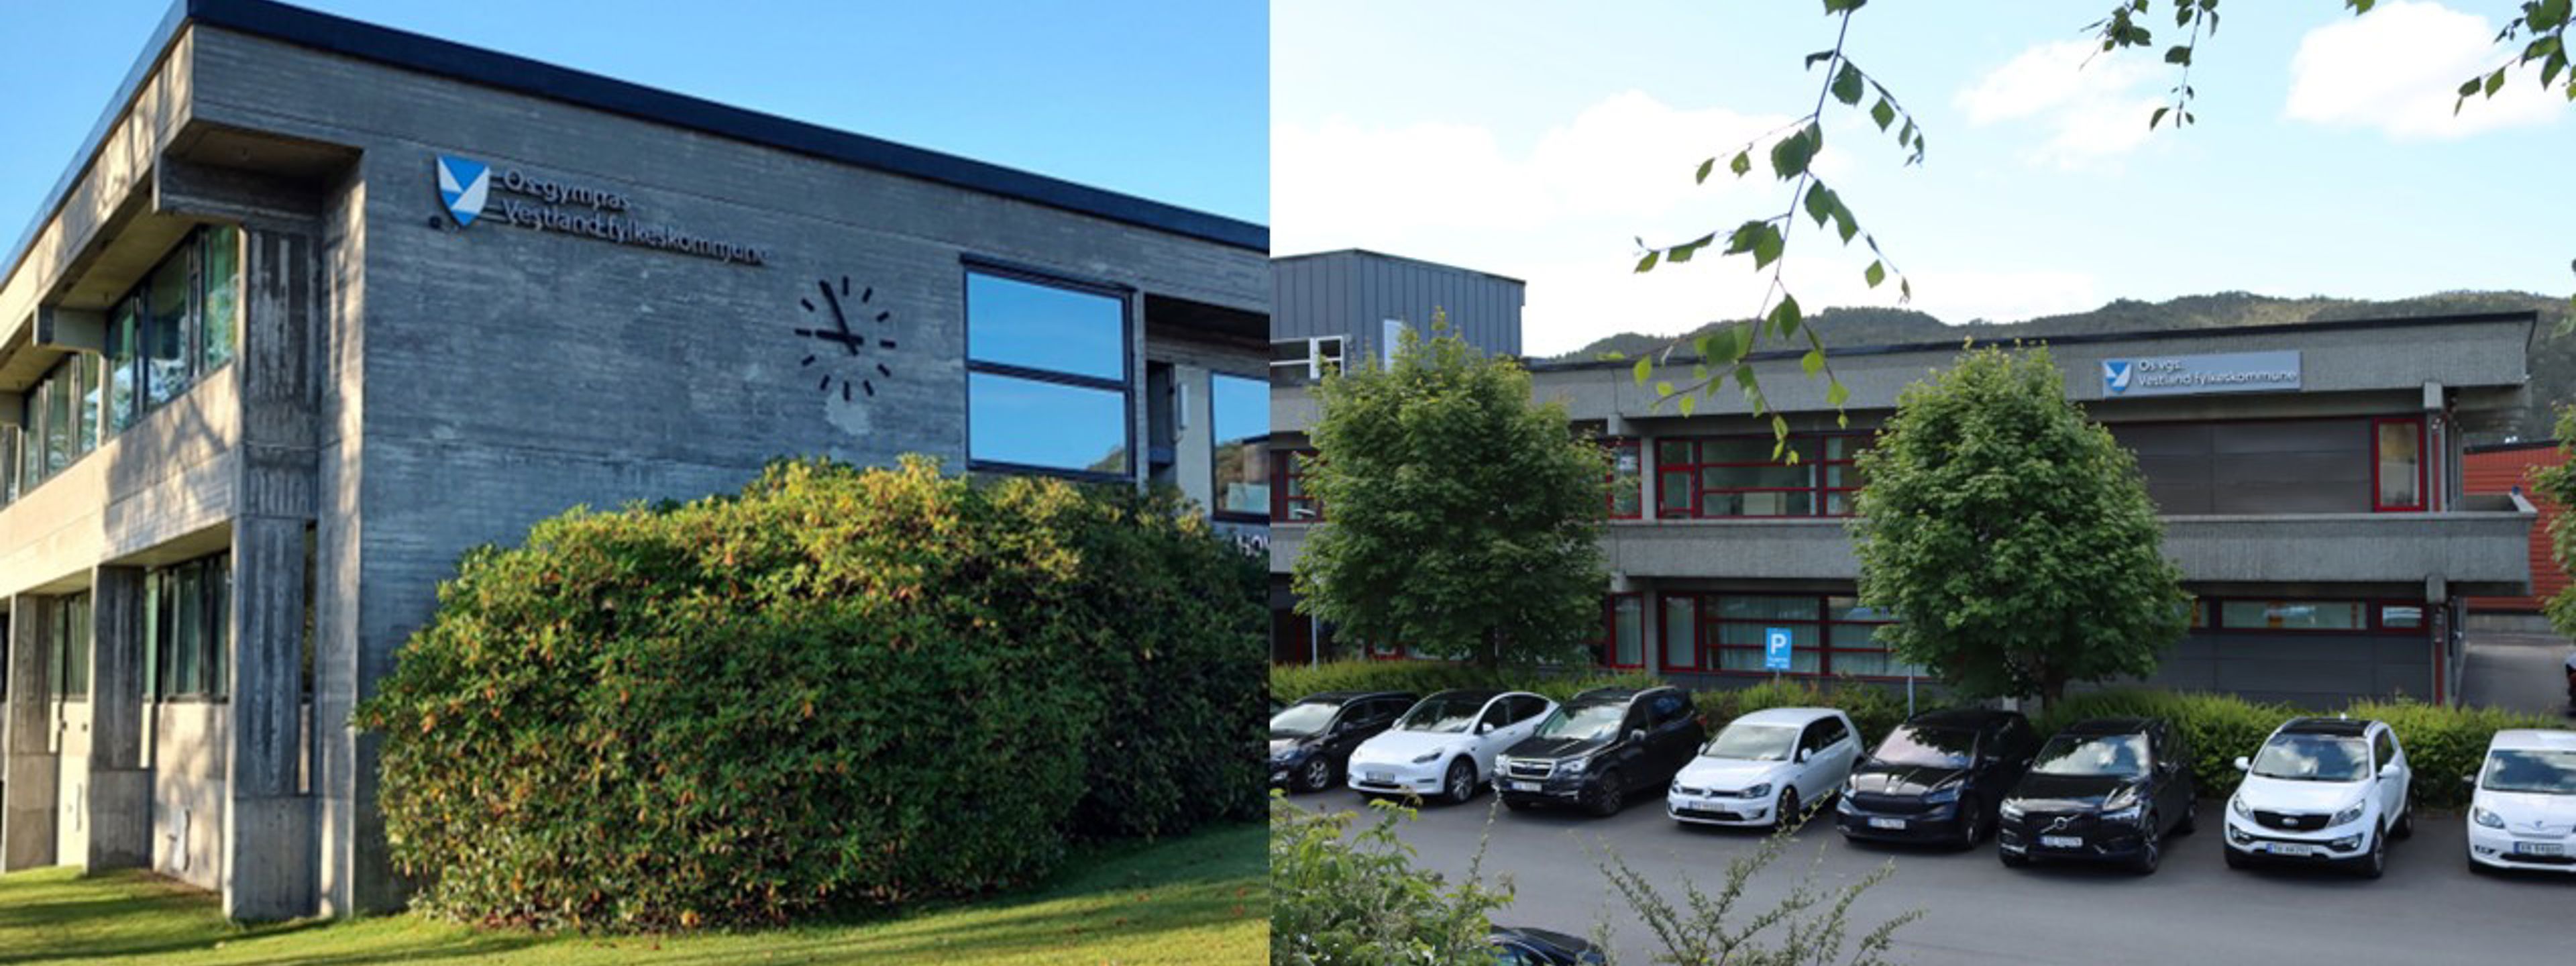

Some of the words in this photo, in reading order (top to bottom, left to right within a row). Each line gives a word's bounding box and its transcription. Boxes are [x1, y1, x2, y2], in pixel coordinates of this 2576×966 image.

[504, 168, 539, 195] Os
[503, 199, 602, 235] Vestland
[607, 213, 771, 262] fylkeskommune
[1770, 633, 1787, 655] P
